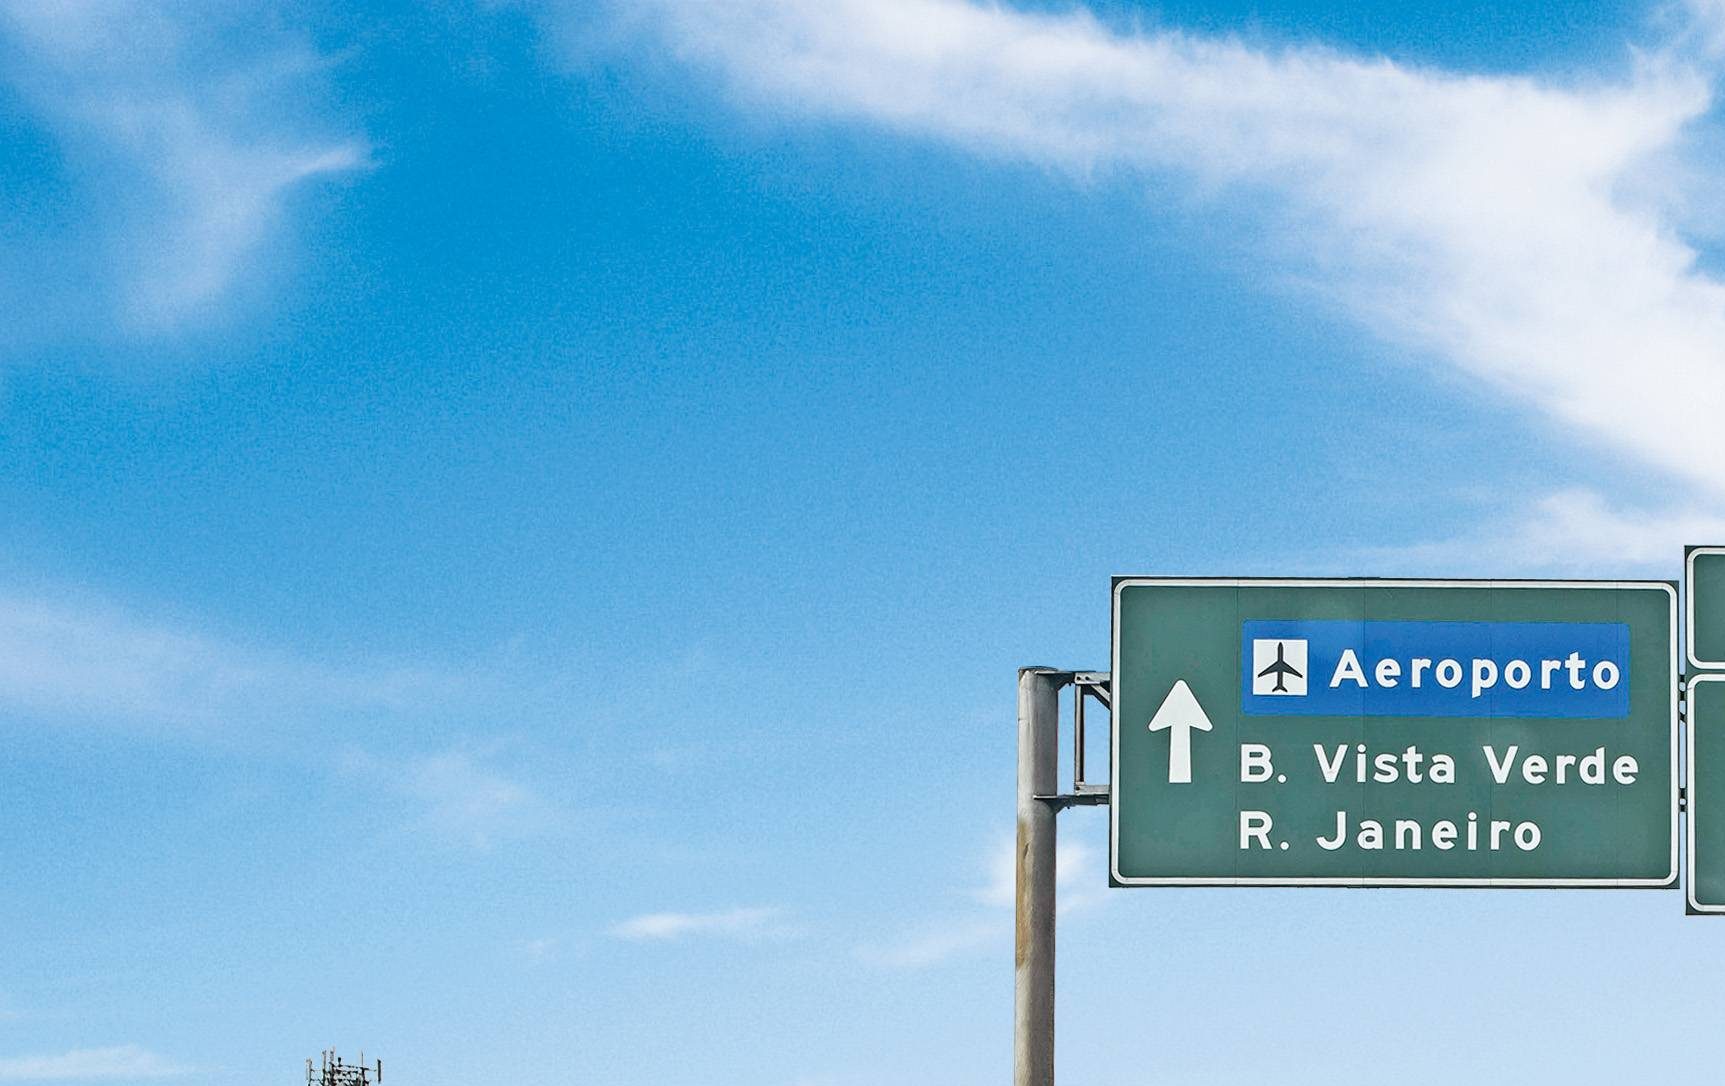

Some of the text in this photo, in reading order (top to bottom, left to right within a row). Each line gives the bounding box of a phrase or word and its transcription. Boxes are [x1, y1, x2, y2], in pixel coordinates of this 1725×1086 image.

[1329, 649, 1620, 698] Aeroporto
[1240, 743, 1639, 785] B. Vista Verde
[1240, 810, 1541, 851] R. Janeiro
